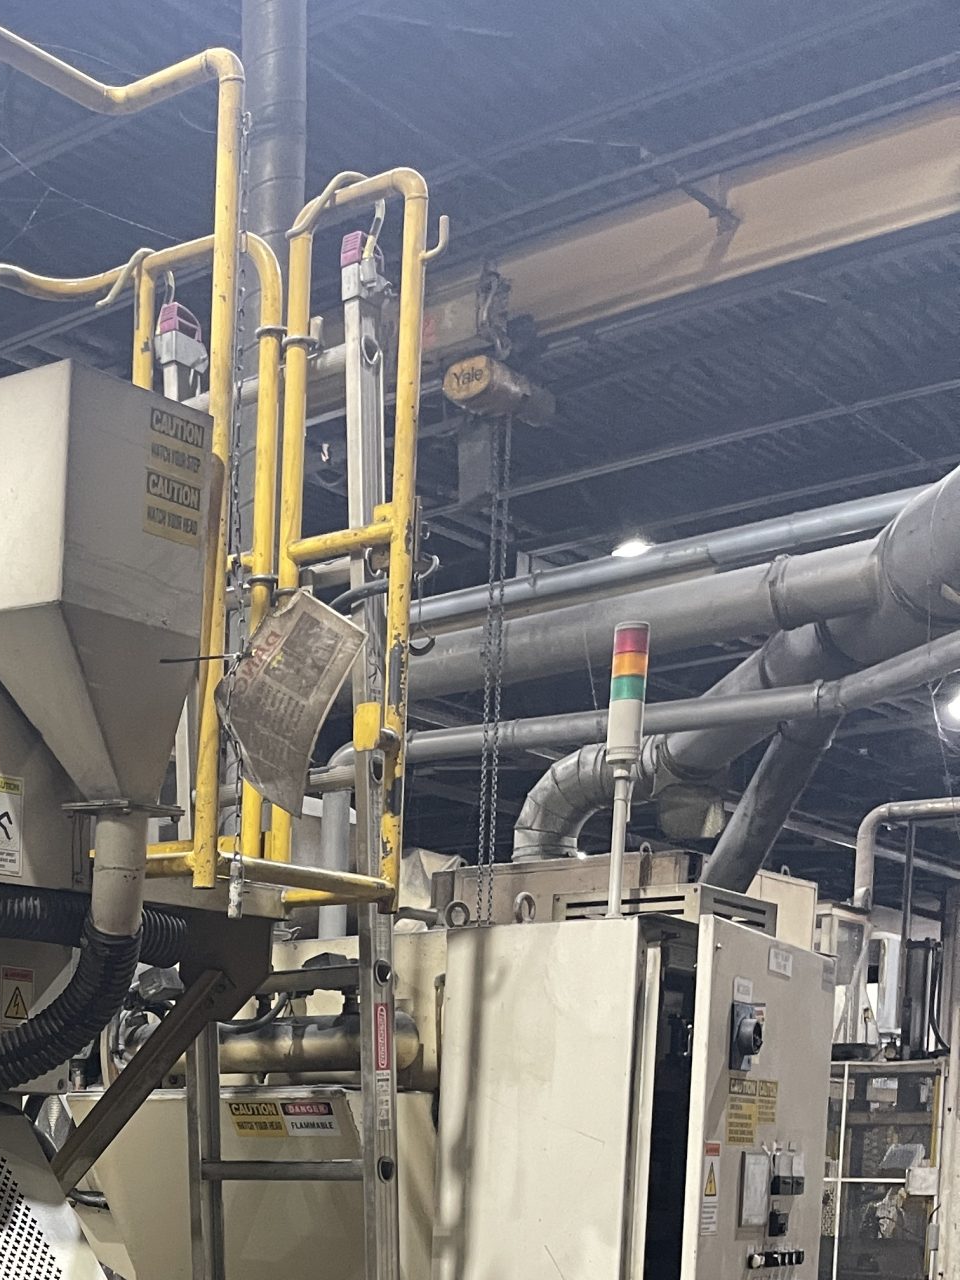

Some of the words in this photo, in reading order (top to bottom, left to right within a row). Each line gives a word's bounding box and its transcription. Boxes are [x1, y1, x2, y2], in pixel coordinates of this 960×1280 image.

[453, 367, 483, 387] Yale
[152, 410, 204, 448] CAUTION
[148, 473, 200, 511] CAUTION
[730, 1079, 756, 1096] CAUTION
[230, 1103, 279, 1115] CAUTION
[288, 1104, 326, 1113] DANGER
[291, 1121, 334, 1130] FLAMMABLE
